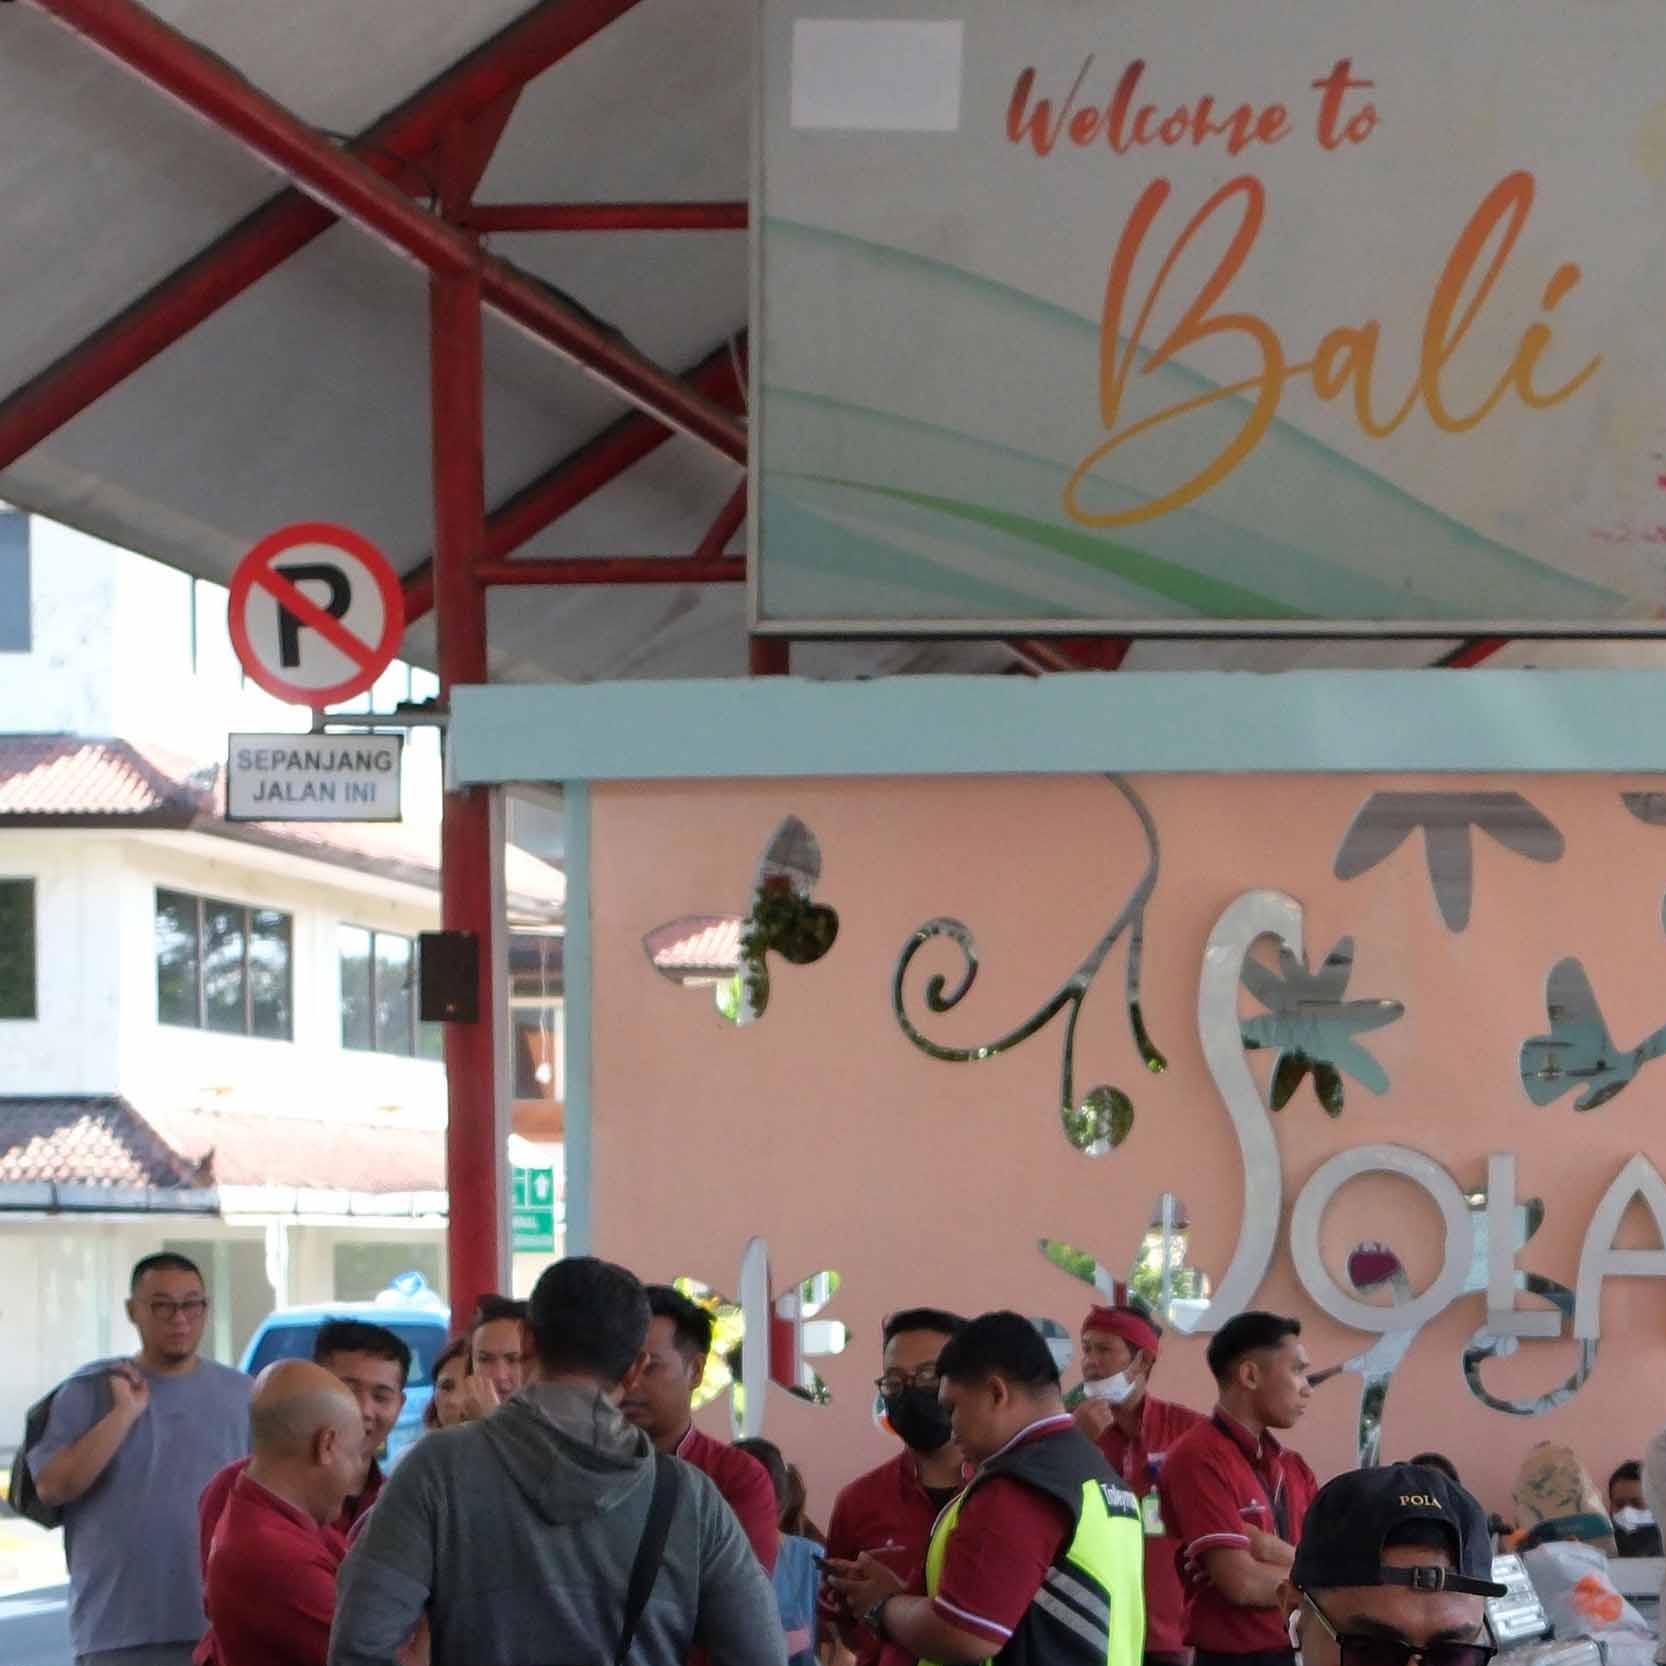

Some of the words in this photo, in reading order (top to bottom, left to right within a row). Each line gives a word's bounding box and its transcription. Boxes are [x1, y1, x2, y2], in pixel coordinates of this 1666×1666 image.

[1005, 53, 1293, 158] Welcome
[1310, 57, 1382, 151] to
[1062, 170, 1602, 530] Bali
[274, 563, 352, 668] P
[236, 749, 394, 773] SEPANJANG
[252, 781, 336, 803] JALAN
[345, 782, 377, 803] INI
